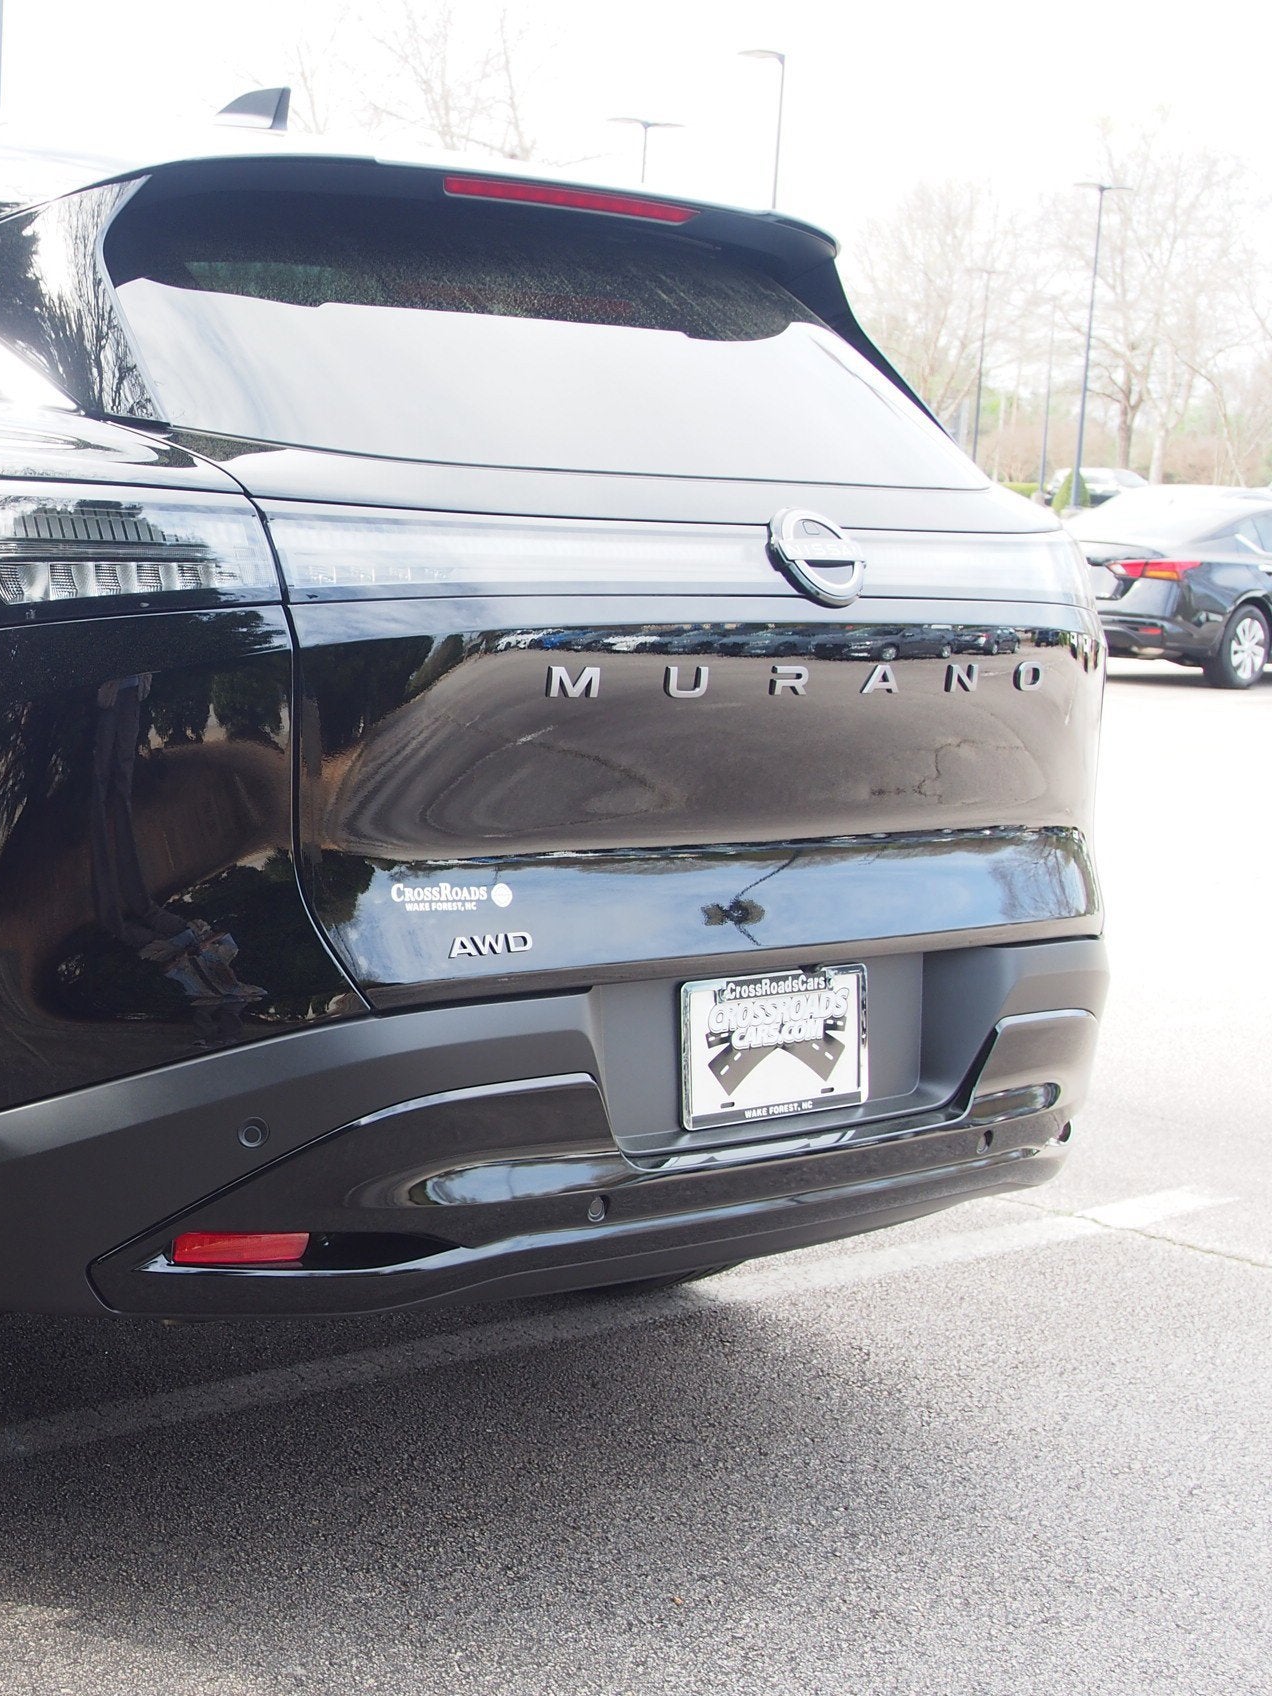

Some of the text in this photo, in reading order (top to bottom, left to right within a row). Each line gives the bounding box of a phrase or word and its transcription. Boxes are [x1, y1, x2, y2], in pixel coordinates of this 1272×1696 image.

[784, 541, 864, 558] NISSAN
[546, 660, 1045, 698] MURANO
[405, 902, 477, 912] WAKE FOREST, NC
[448, 931, 533, 959] AWD
[708, 987, 850, 1034] CROSSROADS
[744, 1108, 768, 1119] WAKE
[801, 1100, 813, 1110] NC
